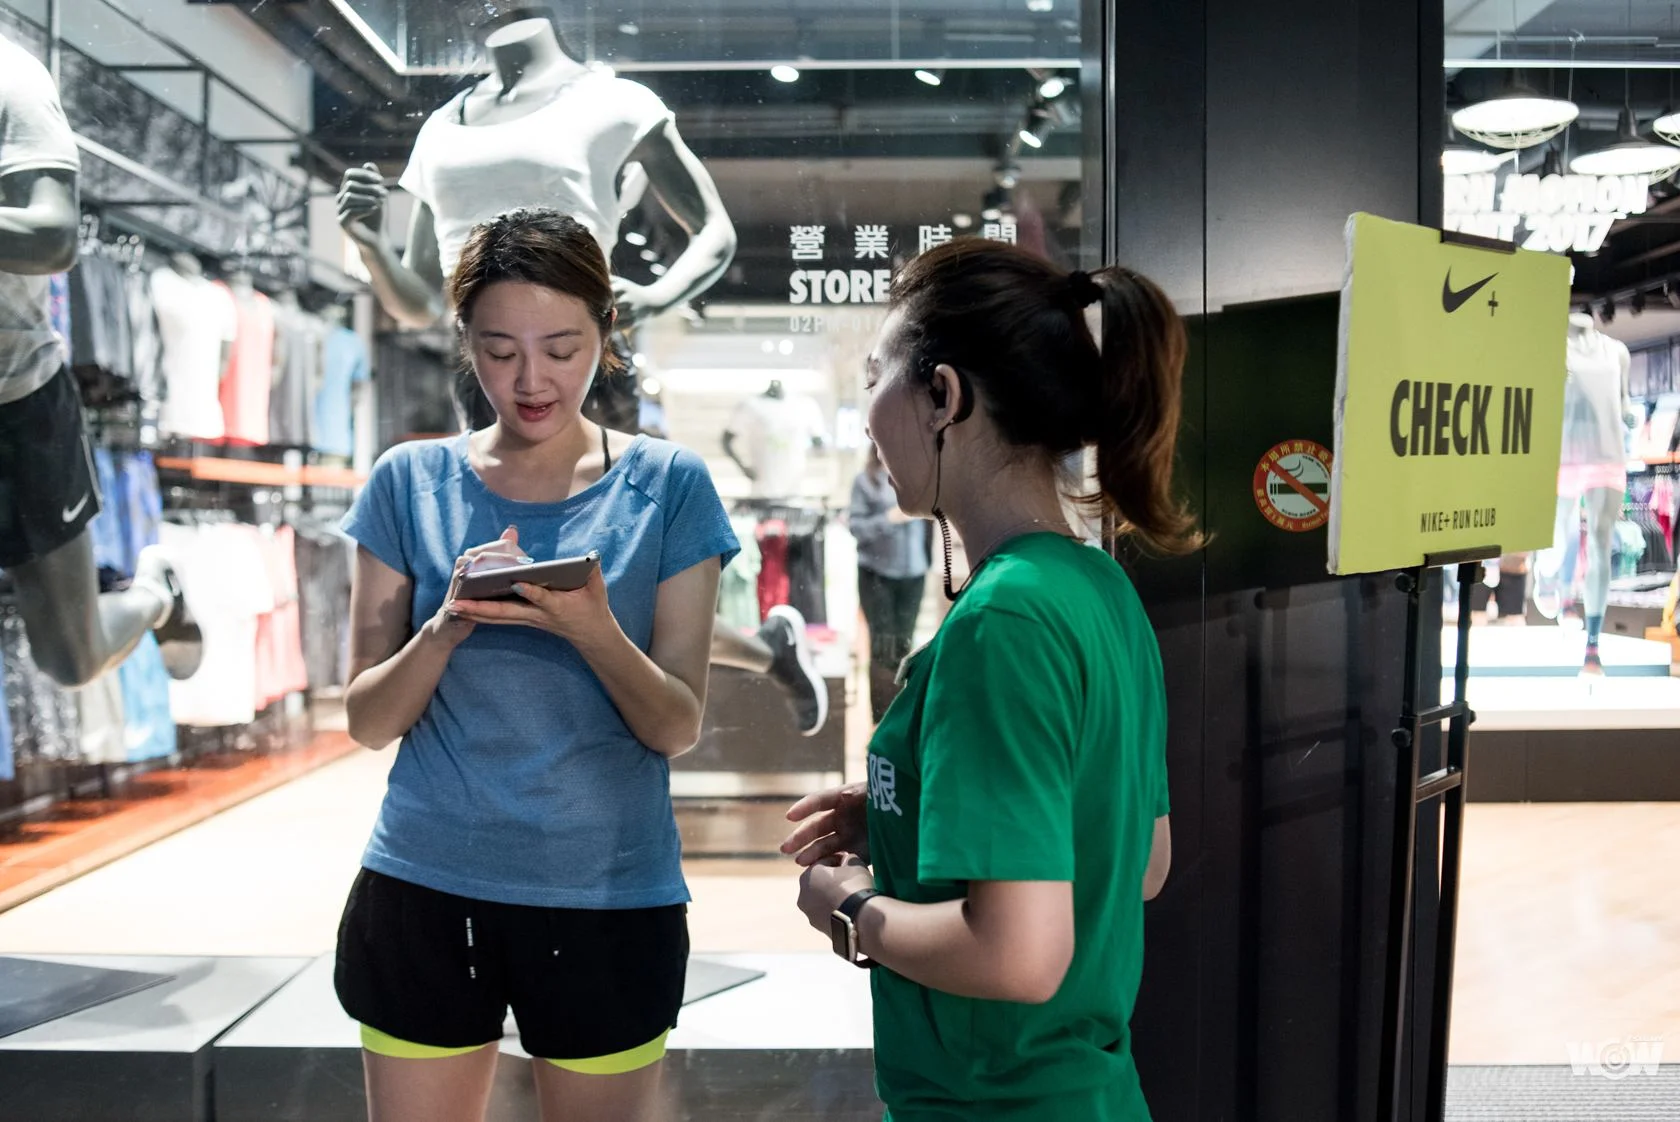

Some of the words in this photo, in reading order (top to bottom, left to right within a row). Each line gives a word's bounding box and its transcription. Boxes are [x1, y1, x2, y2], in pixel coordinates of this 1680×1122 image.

[1502, 175, 1649, 213] MOTION
[1523, 213, 1615, 252] 2017
[789, 269, 891, 304] STORE
[789, 314, 880, 333] 02PM-01
[1390, 379, 1492, 457] CHECK
[1501, 386, 1534, 455] IN
[1420, 510, 1451, 534] NIKE+
[1452, 509, 1472, 530] RUN
[1473, 507, 1497, 528] CLUB
[867, 752, 904, 817] 限
